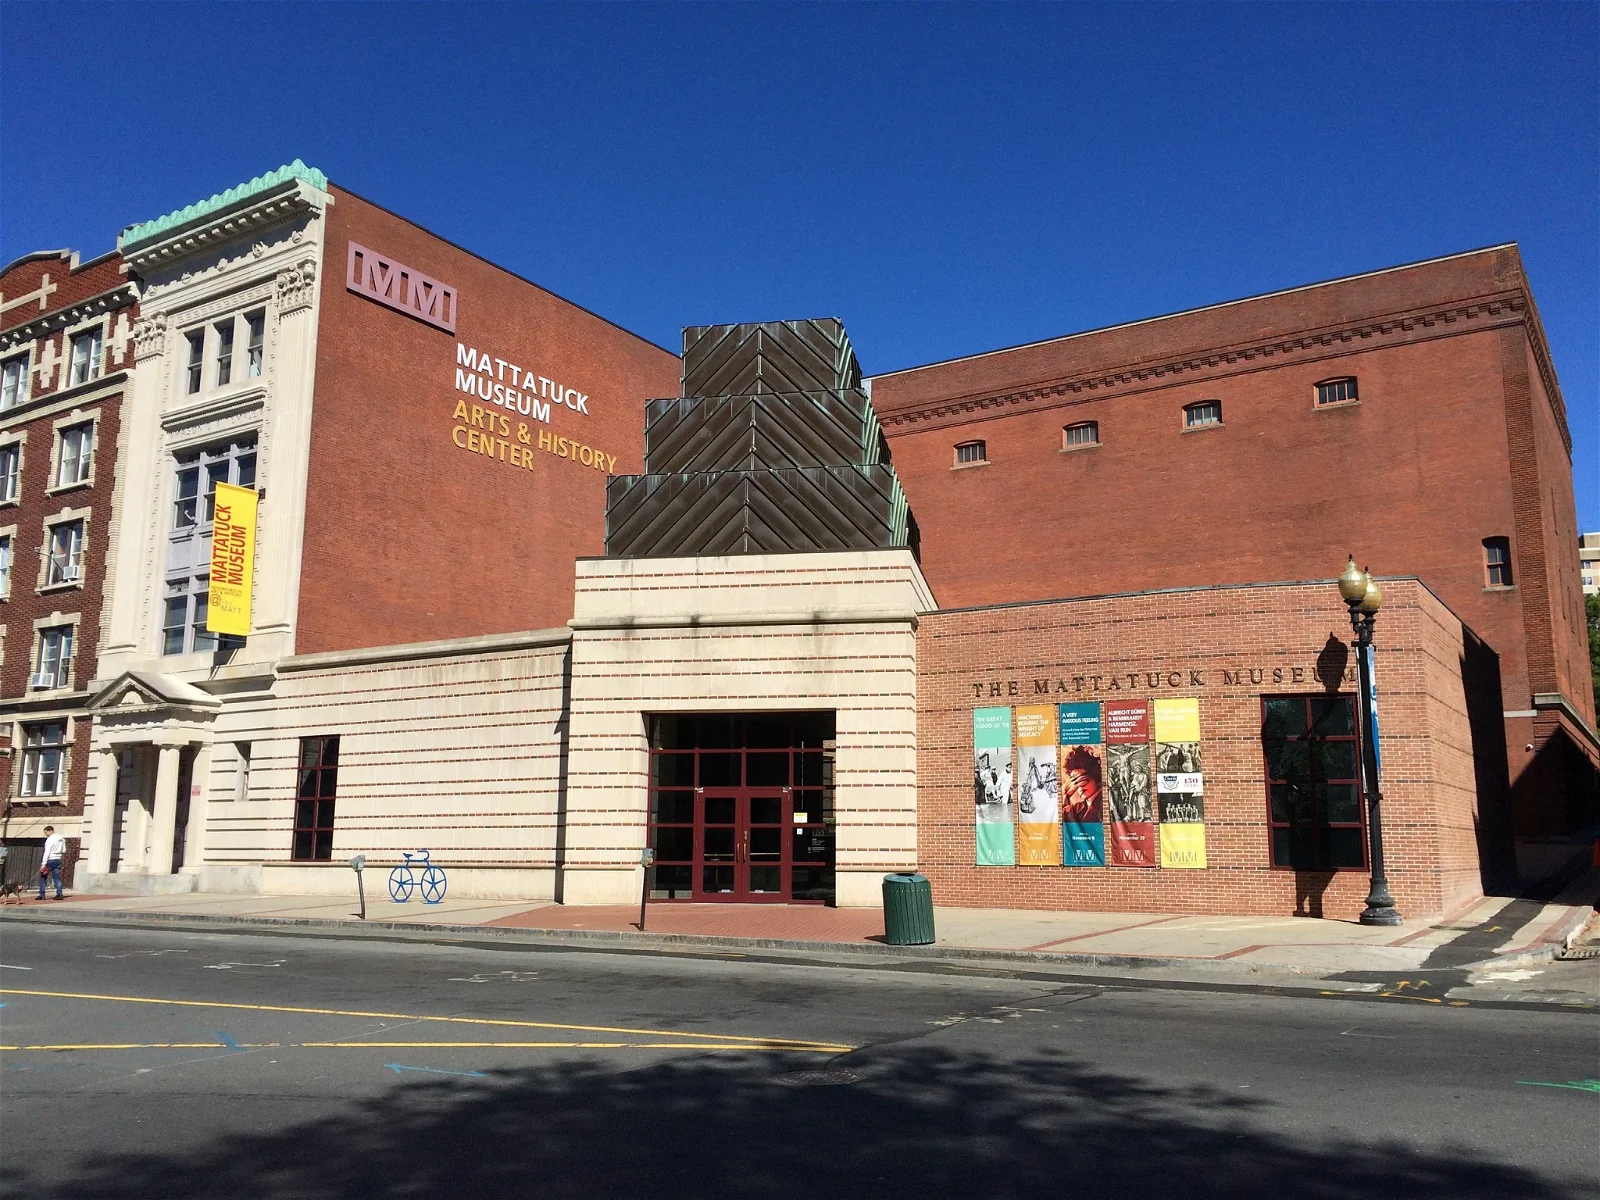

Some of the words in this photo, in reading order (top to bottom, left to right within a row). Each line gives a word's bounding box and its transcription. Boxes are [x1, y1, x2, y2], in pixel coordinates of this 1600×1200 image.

[455, 367, 550, 423] MUSEUM
[456, 342, 589, 415] MATTATUCK
[452, 400, 510, 437] ARTS
[517, 422, 532, 445] &
[538, 429, 617, 474] HISTORY
[452, 425, 534, 470] CENTER
[211, 504, 231, 583] MATTATUCK
[228, 525, 247, 586] MUSEUM
[210, 593, 222, 607] @
[221, 606, 241, 614] MATT
[973, 681, 1019, 697] THE
[1034, 669, 1205, 694] MATTATUCK
[1223, 666, 1357, 685] MUSEUM
